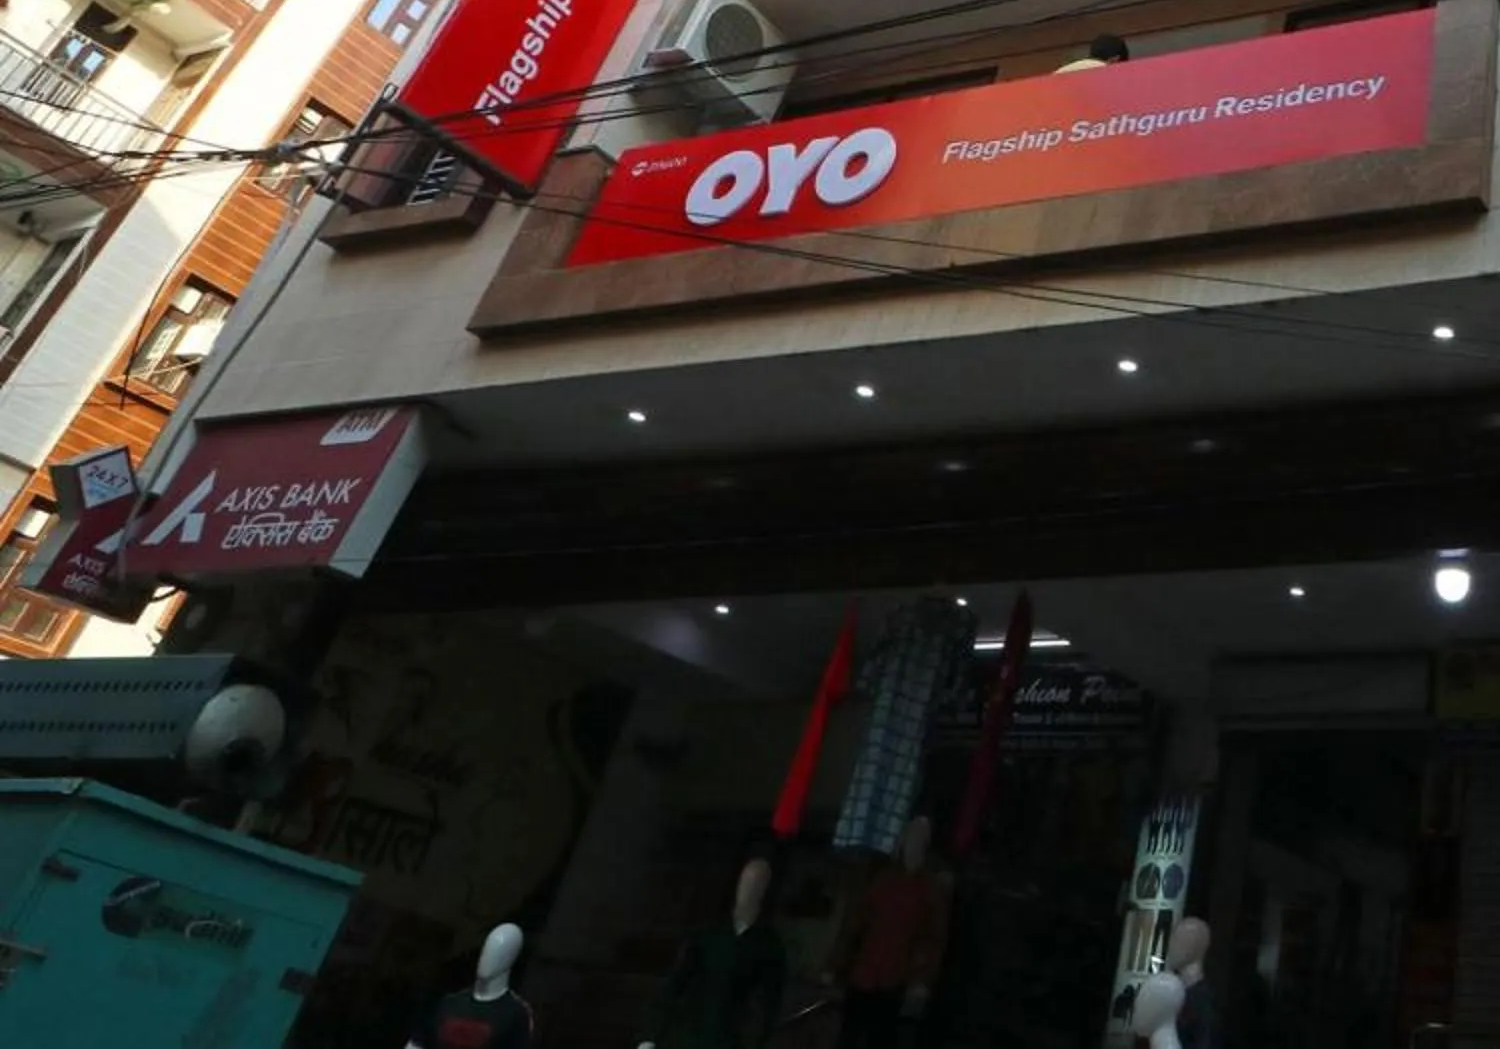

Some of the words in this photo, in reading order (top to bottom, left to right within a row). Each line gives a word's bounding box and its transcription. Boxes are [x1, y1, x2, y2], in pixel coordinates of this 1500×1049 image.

[943, 128, 1063, 164] Flagship
[1068, 107, 1206, 144] Sathguru
[1214, 75, 1386, 119] Residency
[685, 126, 897, 227] OYO
[214, 483, 281, 514] AXIS
[280, 477, 362, 508] BANK
